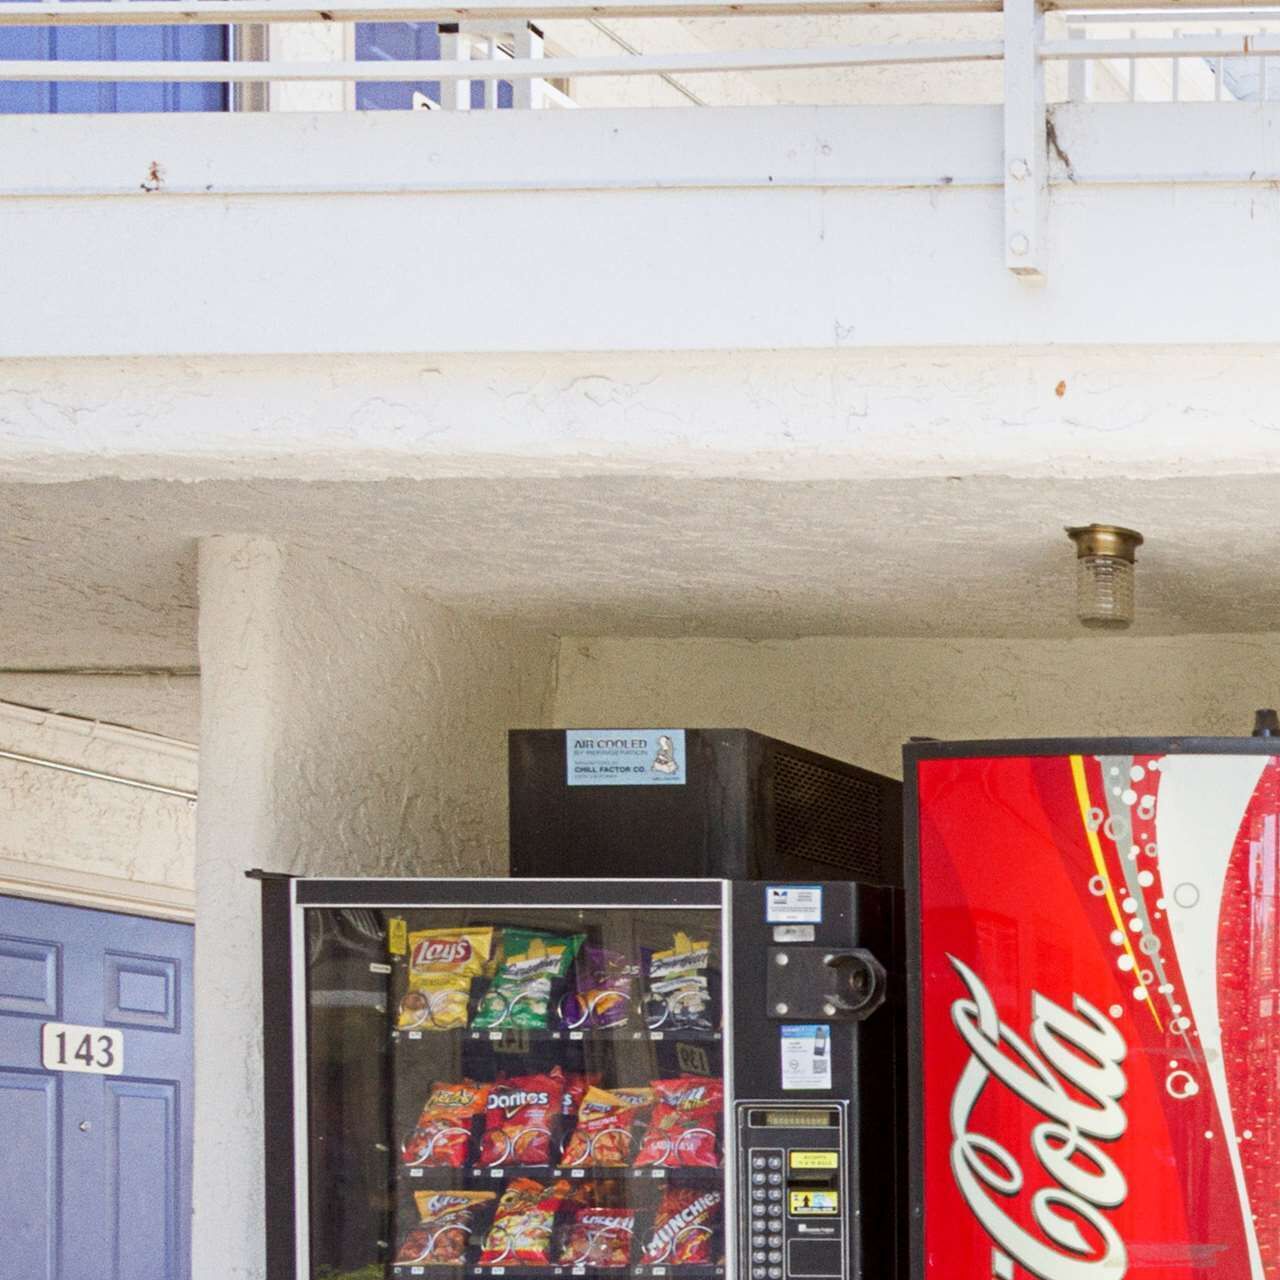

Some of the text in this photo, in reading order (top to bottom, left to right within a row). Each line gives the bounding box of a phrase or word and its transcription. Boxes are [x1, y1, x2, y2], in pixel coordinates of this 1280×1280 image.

[574, 739, 648, 749] AIR COOLED
[55, 1031, 115, 1069] 143
[486, 1091, 549, 1110] Doritos
